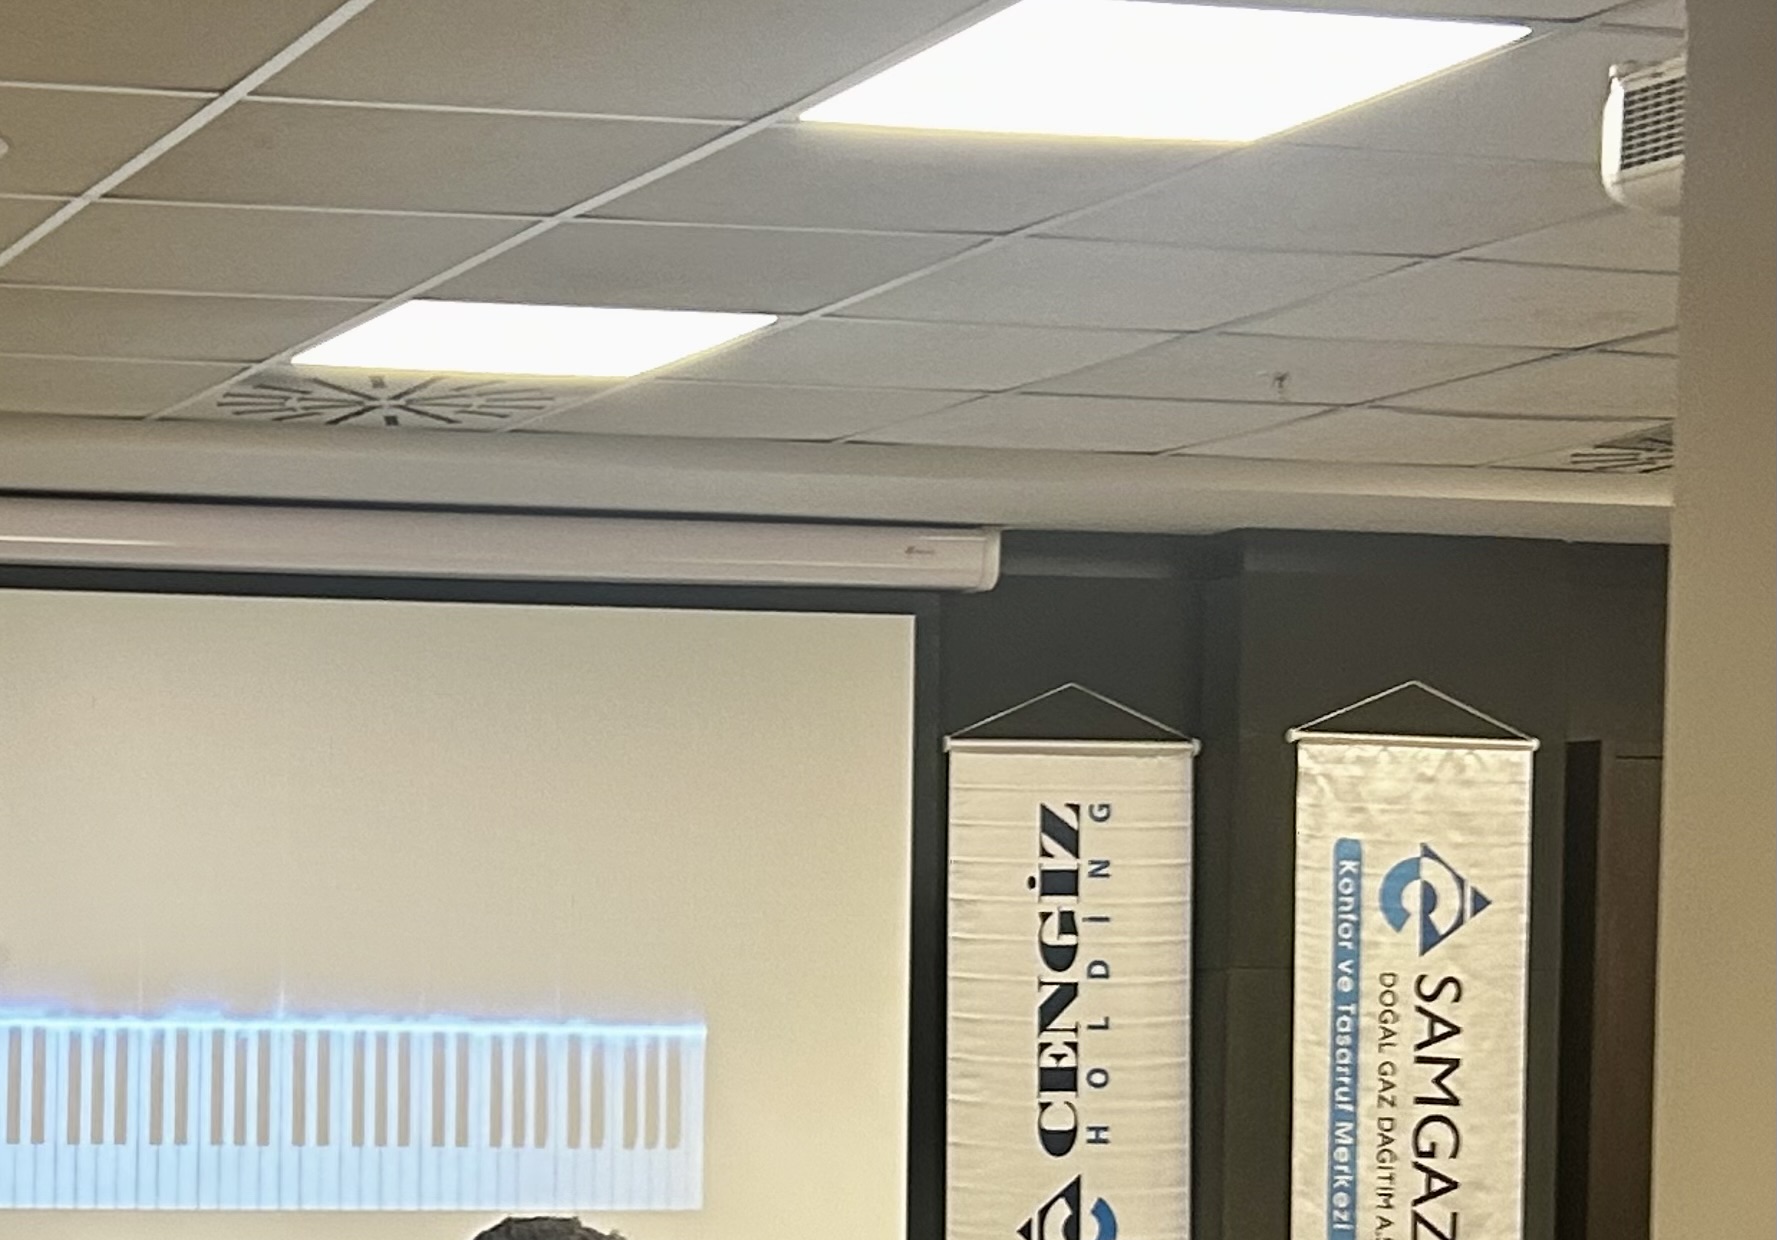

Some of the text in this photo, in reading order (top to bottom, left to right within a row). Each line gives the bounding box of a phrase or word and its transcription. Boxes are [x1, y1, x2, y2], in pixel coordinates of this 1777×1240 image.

[1027, 803, 1081, 1157] CENGİZ
[1377, 972, 1400, 1053] DOĞAL
[1332, 859, 1360, 1231] Konfor ve Tasarruf Merkezi
[1377, 1060, 1398, 1109] GAZ
[1375, 1116, 1398, 1210] DAĞITIM
